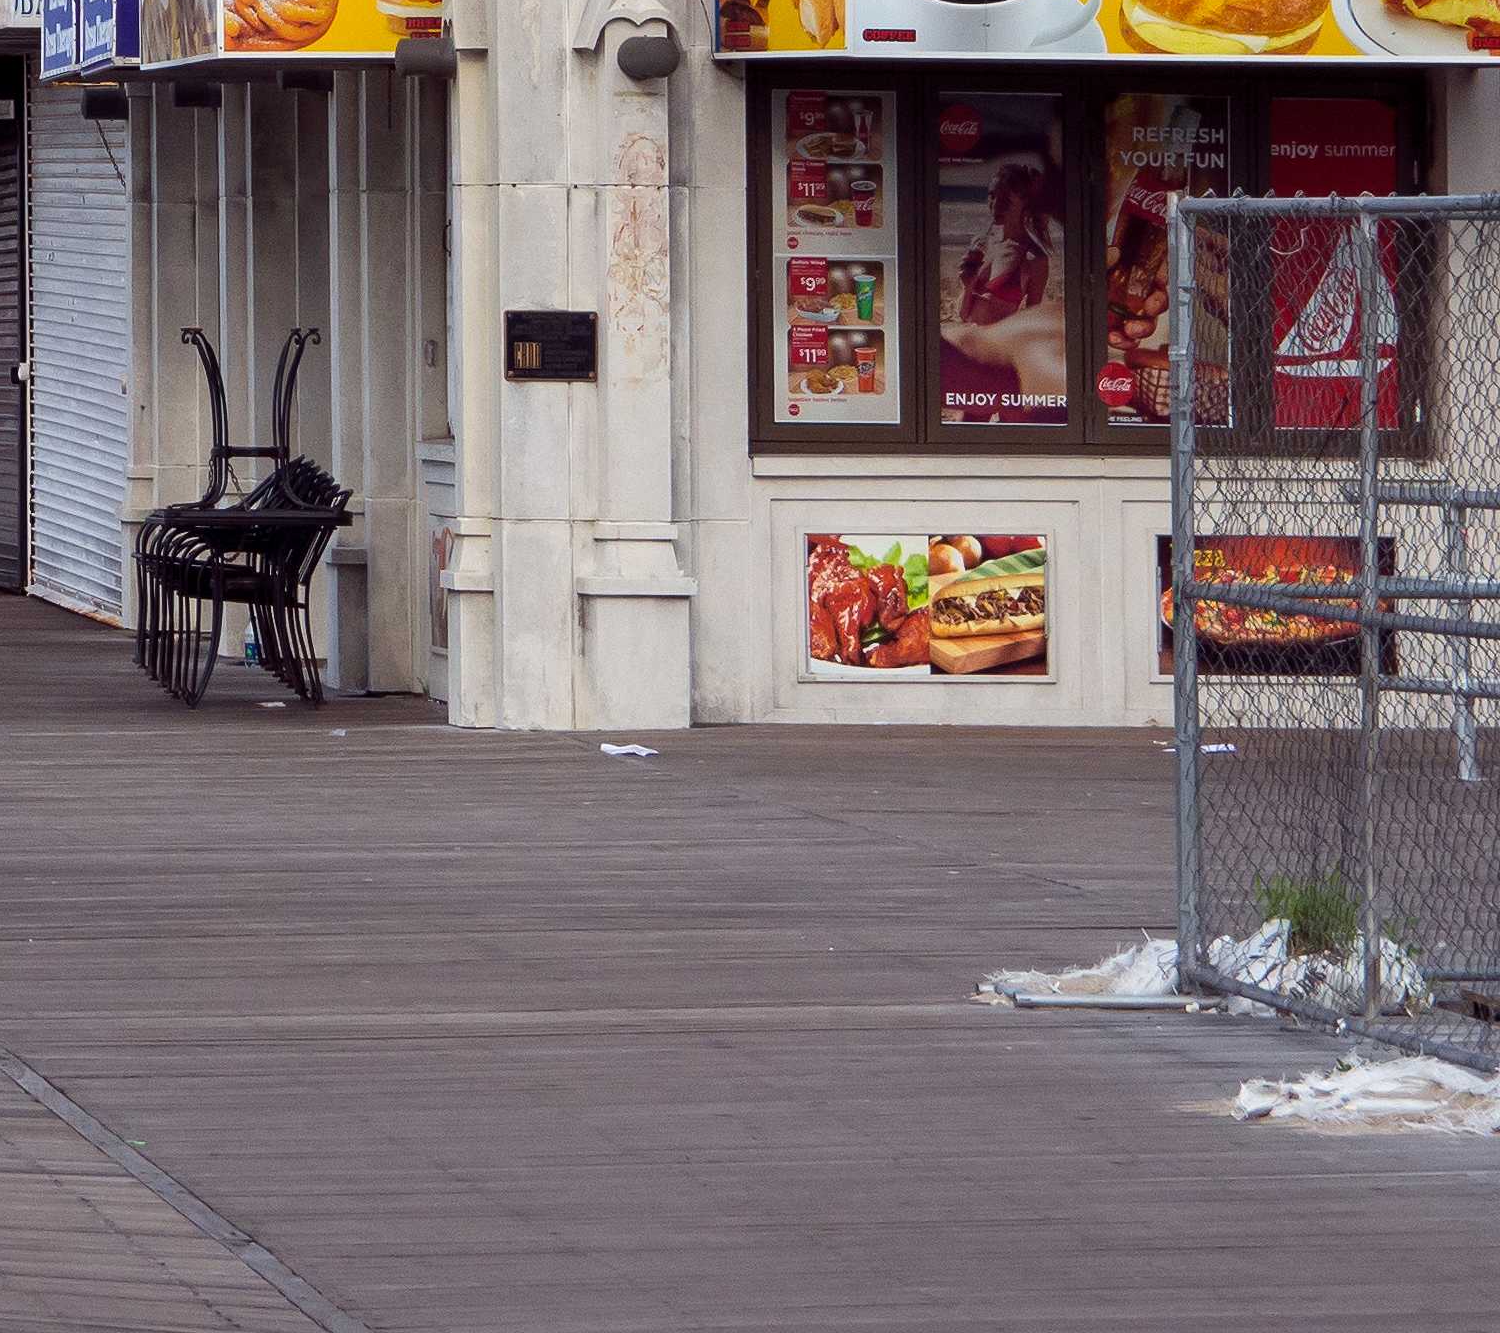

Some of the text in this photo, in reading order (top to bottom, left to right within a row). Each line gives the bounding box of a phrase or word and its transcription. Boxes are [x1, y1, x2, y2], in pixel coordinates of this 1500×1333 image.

[1133, 126, 1225, 145] REFRESH
[1323, 144, 1397, 158] summer
[1119, 151, 1226, 169] YOUR FUN
[1098, 376, 1134, 392] Coca-Cola
[945, 392, 1067, 408] ENJOY SUMMER
